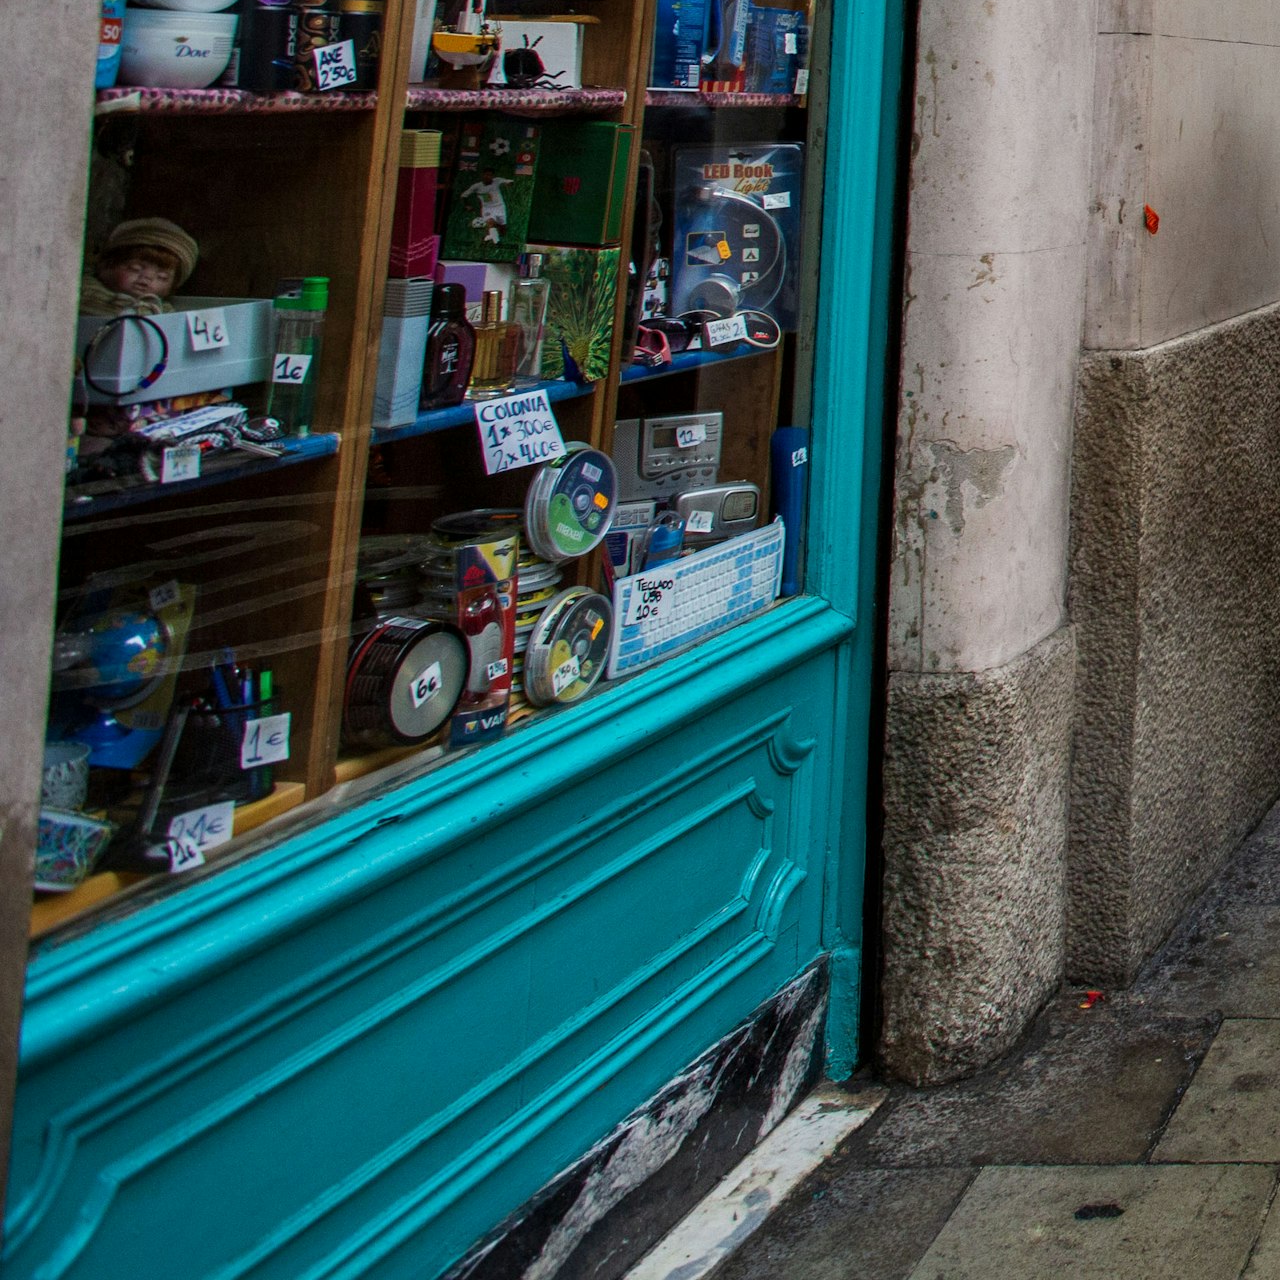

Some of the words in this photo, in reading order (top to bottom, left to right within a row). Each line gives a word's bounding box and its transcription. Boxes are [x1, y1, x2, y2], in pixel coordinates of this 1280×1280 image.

[174, 44, 212, 59] Dove
[318, 47, 345, 70] AXE
[703, 163, 731, 180] LED
[733, 162, 775, 179] Book
[733, 177, 773, 195] Light
[193, 314, 225, 345] 4€
[275, 356, 304, 381] 1€
[479, 395, 549, 423] COLONIA
[555, 521, 585, 543] maxell
[635, 577, 675, 591] TECLADO
[641, 591, 663, 604] USB
[245, 724, 284, 763] 1€
